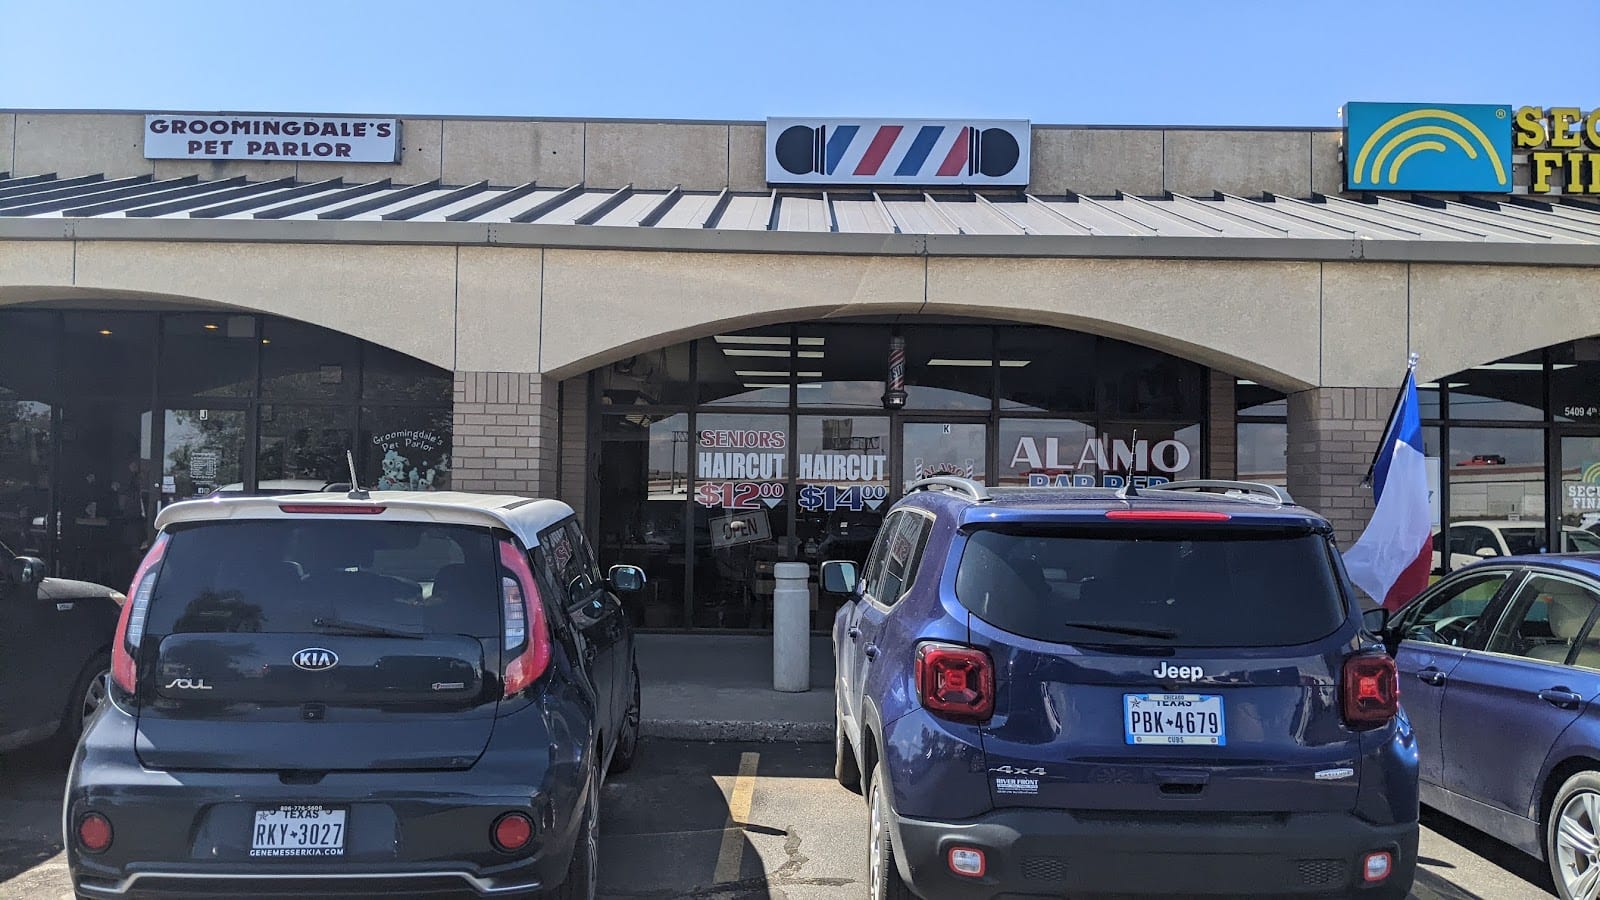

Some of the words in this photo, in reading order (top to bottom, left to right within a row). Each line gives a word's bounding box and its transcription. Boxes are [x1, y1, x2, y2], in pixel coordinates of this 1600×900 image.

[150, 119, 391, 138] GROOMINGDALE'S
[188, 140, 233, 155] PET
[247, 141, 352, 158] PARLOR
[1564, 406, 1585, 416] 5409
[372, 428, 443, 446] Groomingdale's
[943, 425, 950, 433] K
[381, 441, 400, 452] Pet
[405, 438, 434, 452] Parlor
[700, 429, 785, 449] SENIORS
[1009, 436, 1191, 474] ALAMO
[698, 452, 785, 480] HAIRCUT
[799, 453, 887, 481] HAIRCUT
[722, 517, 758, 540] OPEN
[299, 652, 330, 666] KIA
[1153, 661, 1203, 682] Jeep
[165, 677, 213, 690] SOUL
[1175, 711, 1218, 734] 4679
[283, 810, 320, 819] TEXAS
[298, 823, 342, 846] 3027
[249, 848, 344, 857] GENEMESSERKIA.COM
